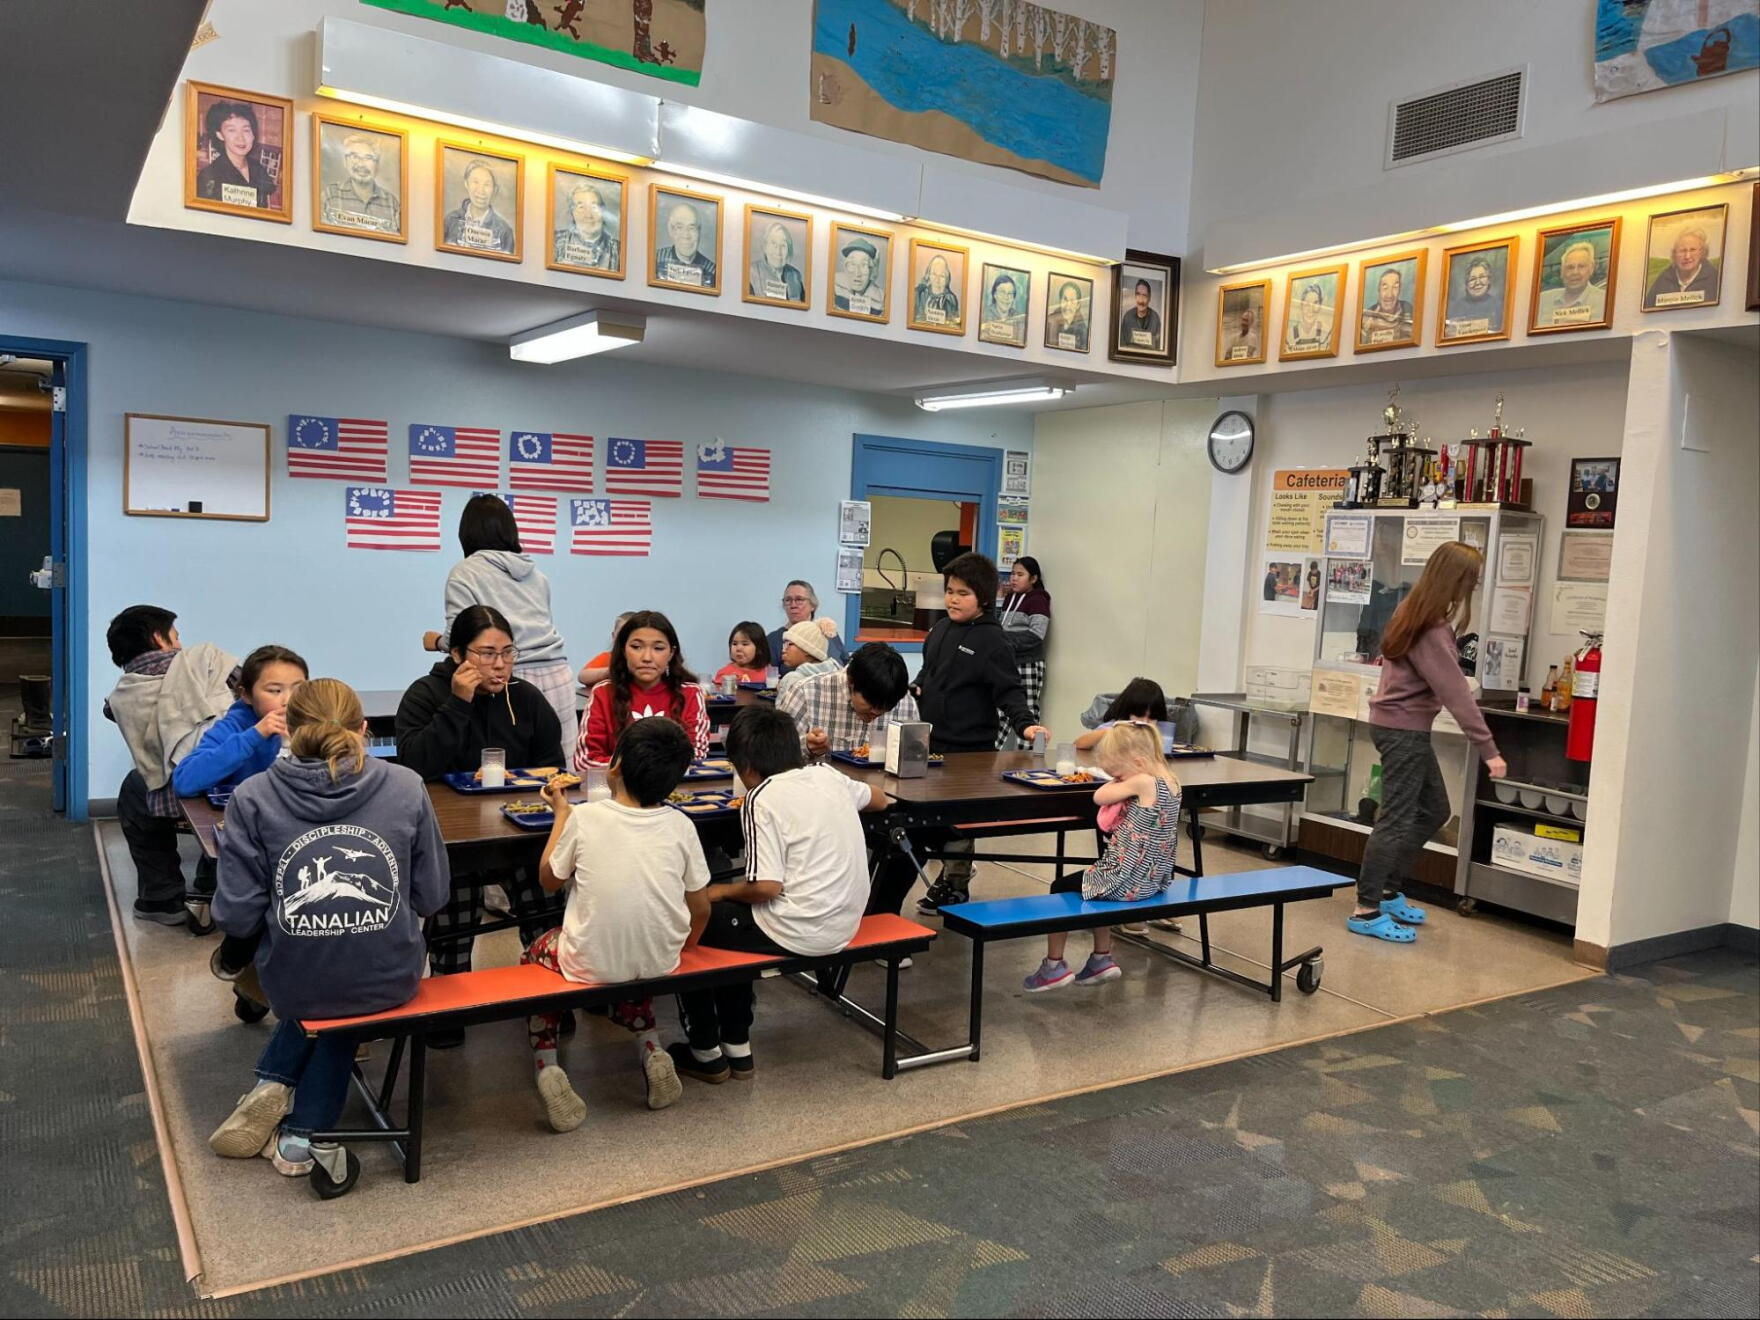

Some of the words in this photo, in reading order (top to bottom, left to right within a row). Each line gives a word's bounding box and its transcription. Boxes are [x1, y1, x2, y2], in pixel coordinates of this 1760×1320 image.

[1286, 473, 1346, 488] Cafeteria
[276, 857, 289, 896] GOSPEL
[292, 826, 366, 851] DISCIPLESHIP
[372, 837, 399, 887] ADVENTURE
[286, 907, 390, 930] TANALIAN
[290, 928, 345, 937] LEADERSHIP
[351, 922, 384, 934] CENTER
